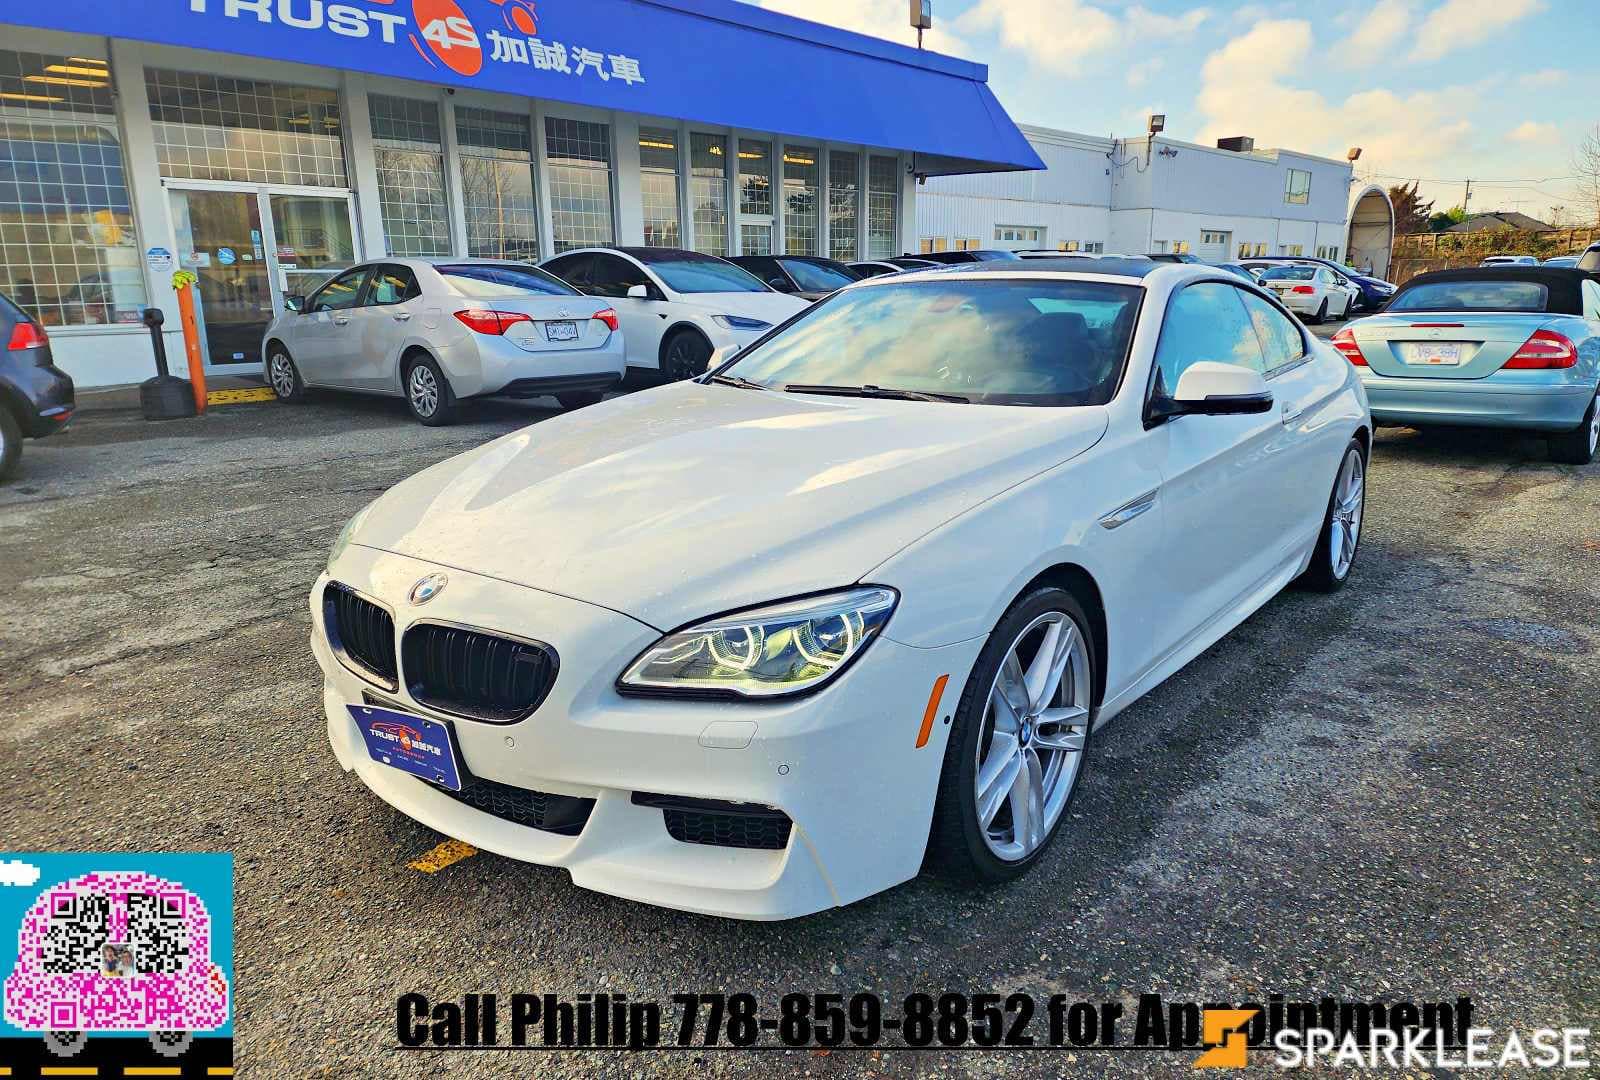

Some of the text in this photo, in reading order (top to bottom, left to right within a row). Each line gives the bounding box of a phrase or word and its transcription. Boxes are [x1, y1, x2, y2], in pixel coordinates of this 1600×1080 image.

[422, 17, 480, 49] 4S
[486, 29, 645, 86] 加誠汽車
